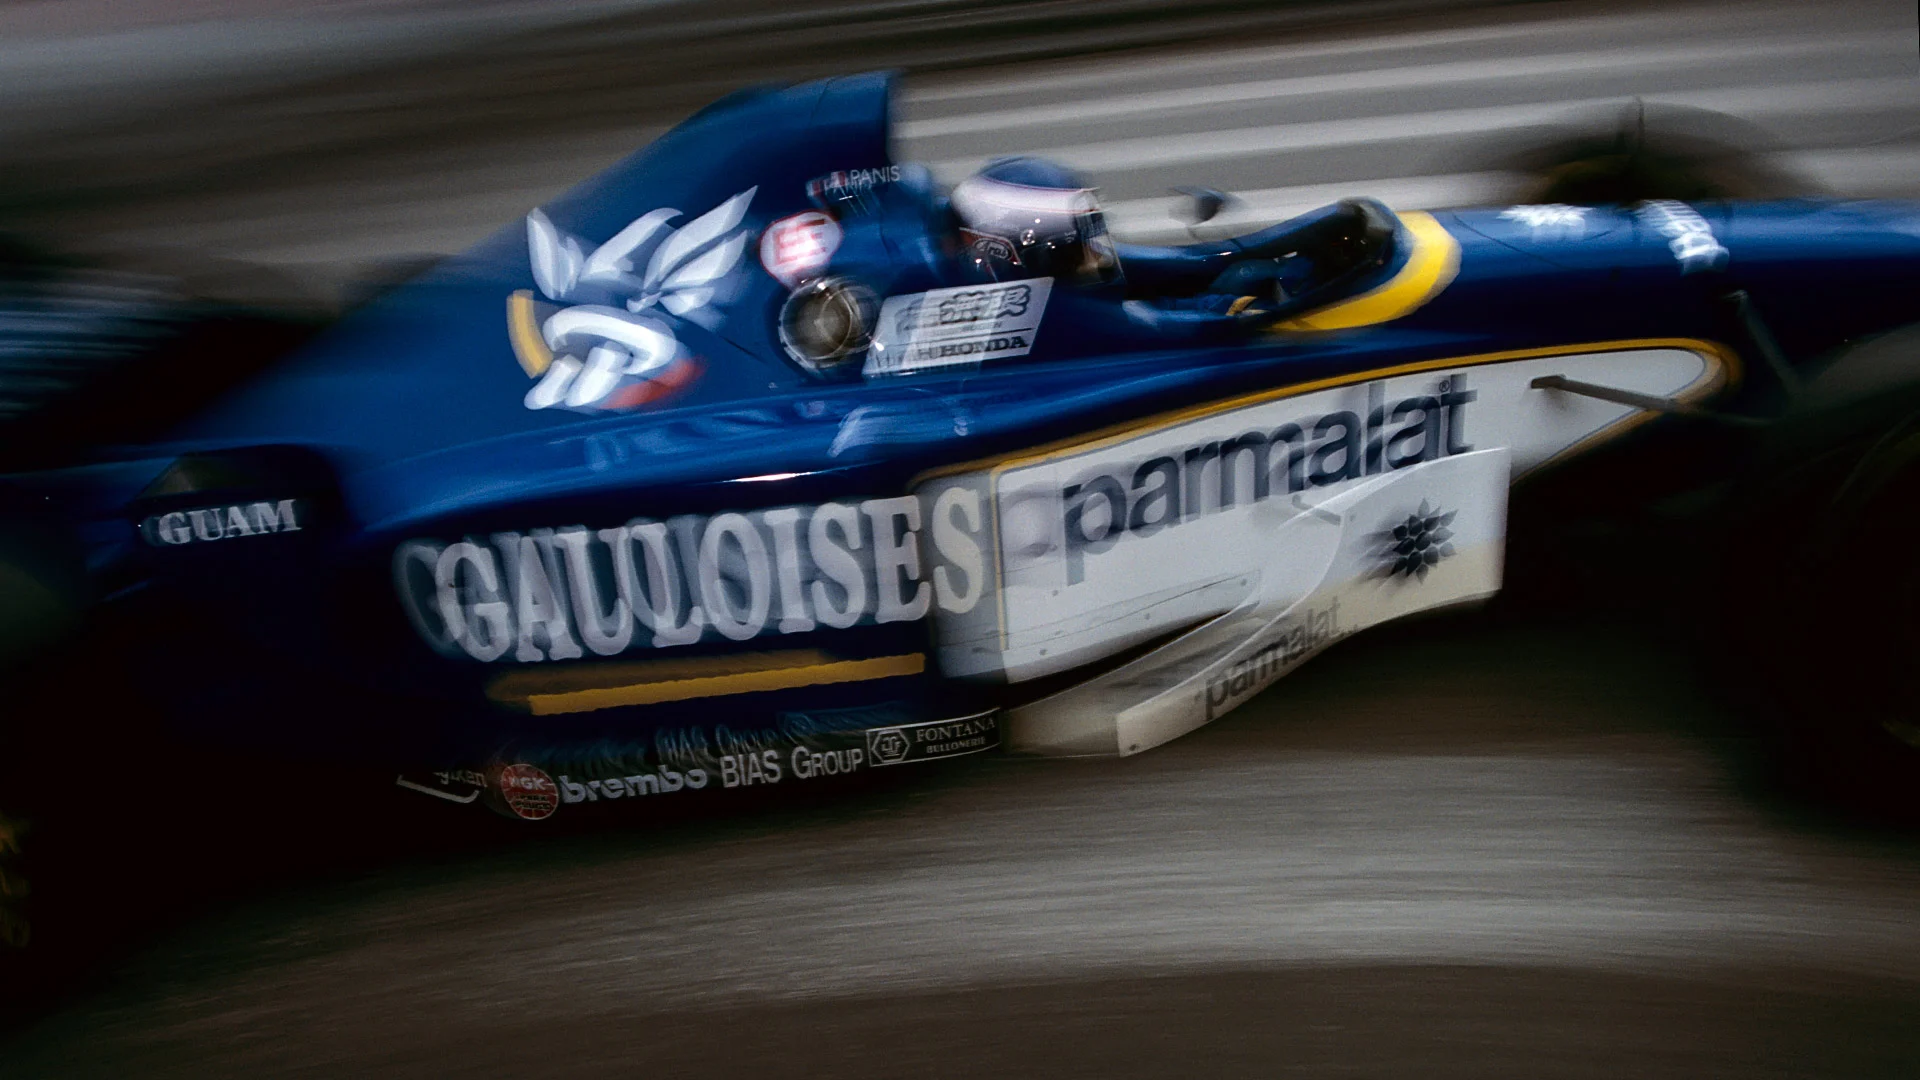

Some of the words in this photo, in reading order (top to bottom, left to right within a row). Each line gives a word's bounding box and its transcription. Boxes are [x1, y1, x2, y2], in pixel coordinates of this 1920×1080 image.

[849, 165, 901, 185] PANIS
[1063, 373, 1479, 586] parmalat
[157, 498, 303, 546] GUAM
[434, 487, 982, 663] GAULOISES
[915, 716, 997, 744] FONTANA
[559, 764, 709, 804] brembo
[719, 749, 784, 788] BIAS
